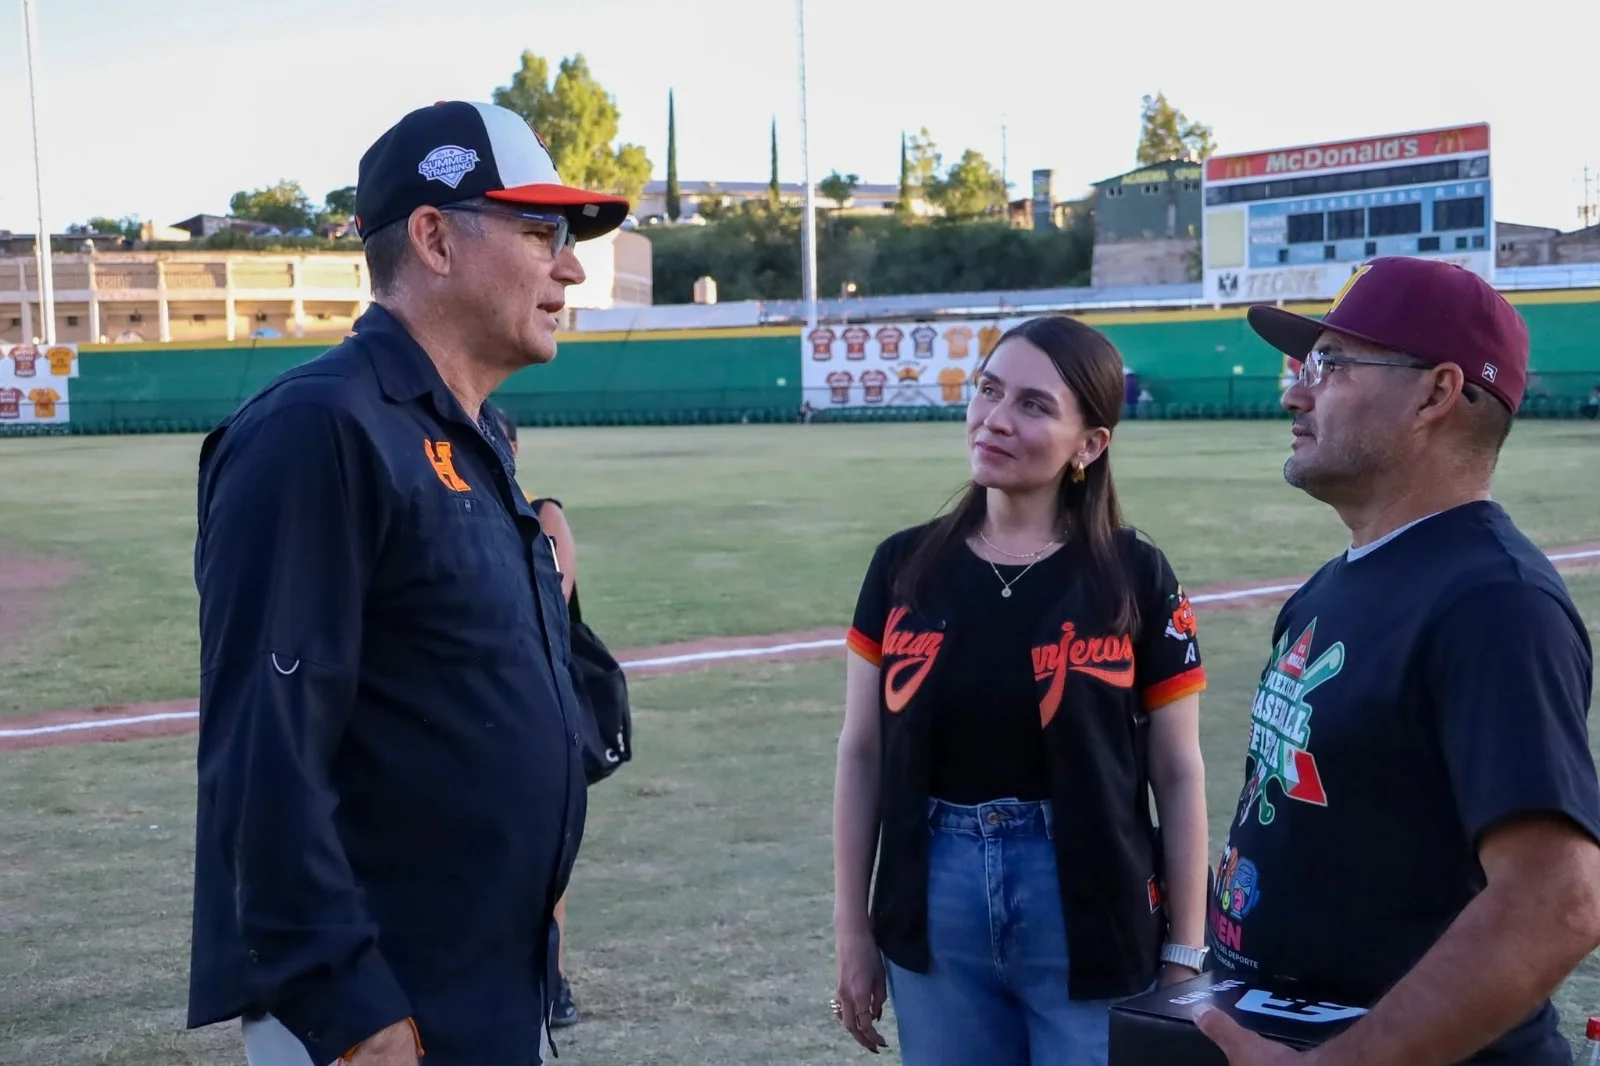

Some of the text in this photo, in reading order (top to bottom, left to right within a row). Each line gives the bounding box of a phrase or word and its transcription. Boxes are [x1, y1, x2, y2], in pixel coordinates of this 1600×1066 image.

[421, 152, 474, 172] SUMMER
[1265, 138, 1419, 173] McDonald's
[427, 162, 472, 178] TRAINING
[423, 438, 471, 492] H
[1228, 949, 1259, 969] DEPORTE
